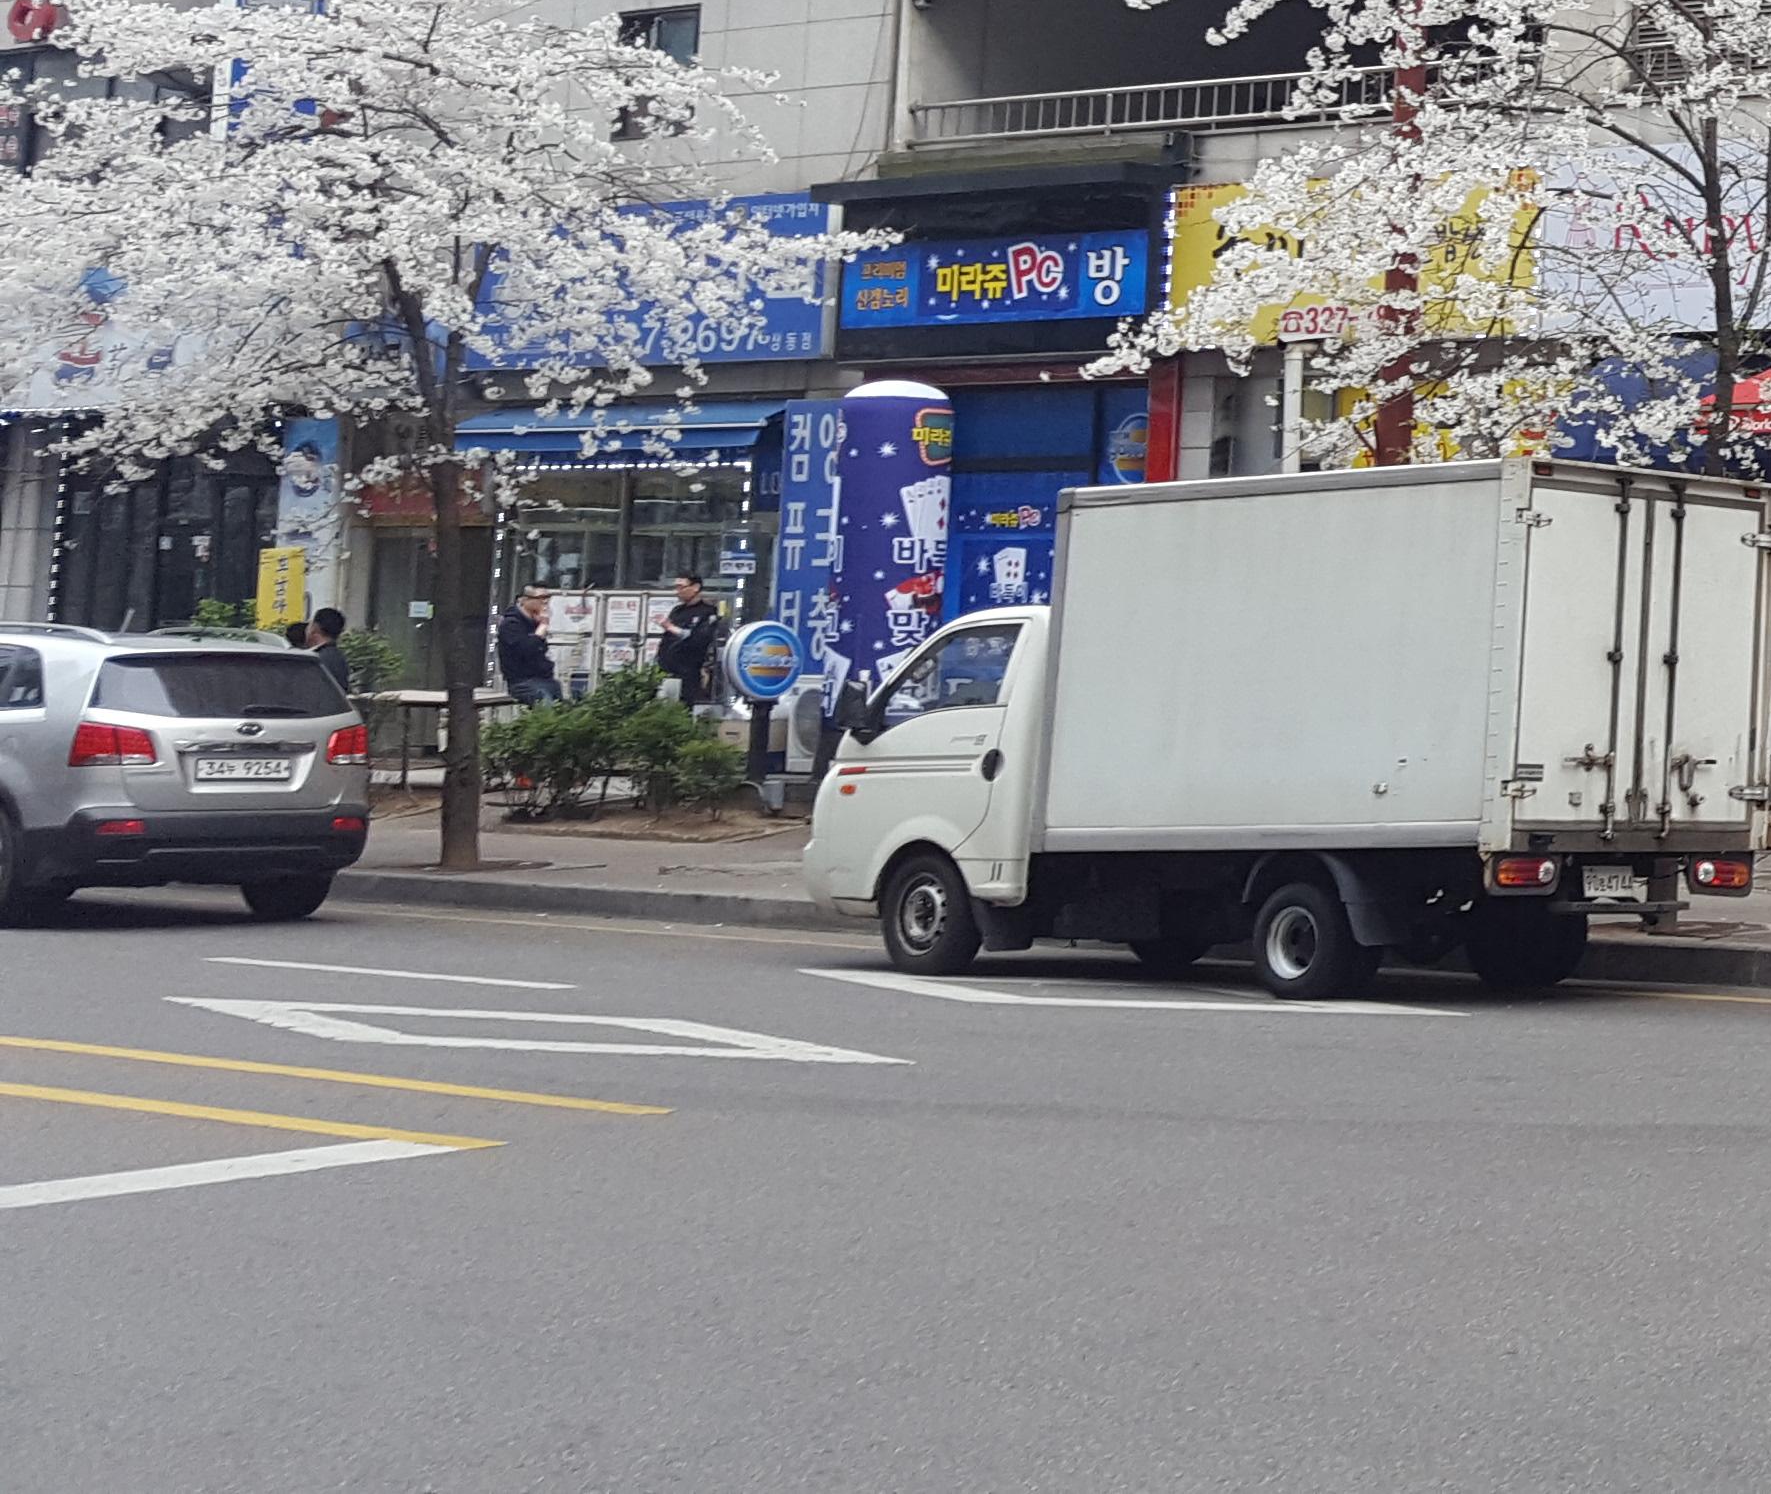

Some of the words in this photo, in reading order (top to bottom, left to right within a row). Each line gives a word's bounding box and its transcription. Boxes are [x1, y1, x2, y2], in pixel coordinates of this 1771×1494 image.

[936, 262, 1008, 300] 미라쥬
[1006, 240, 1064, 299] PC
[1087, 246, 1130, 306] 방
